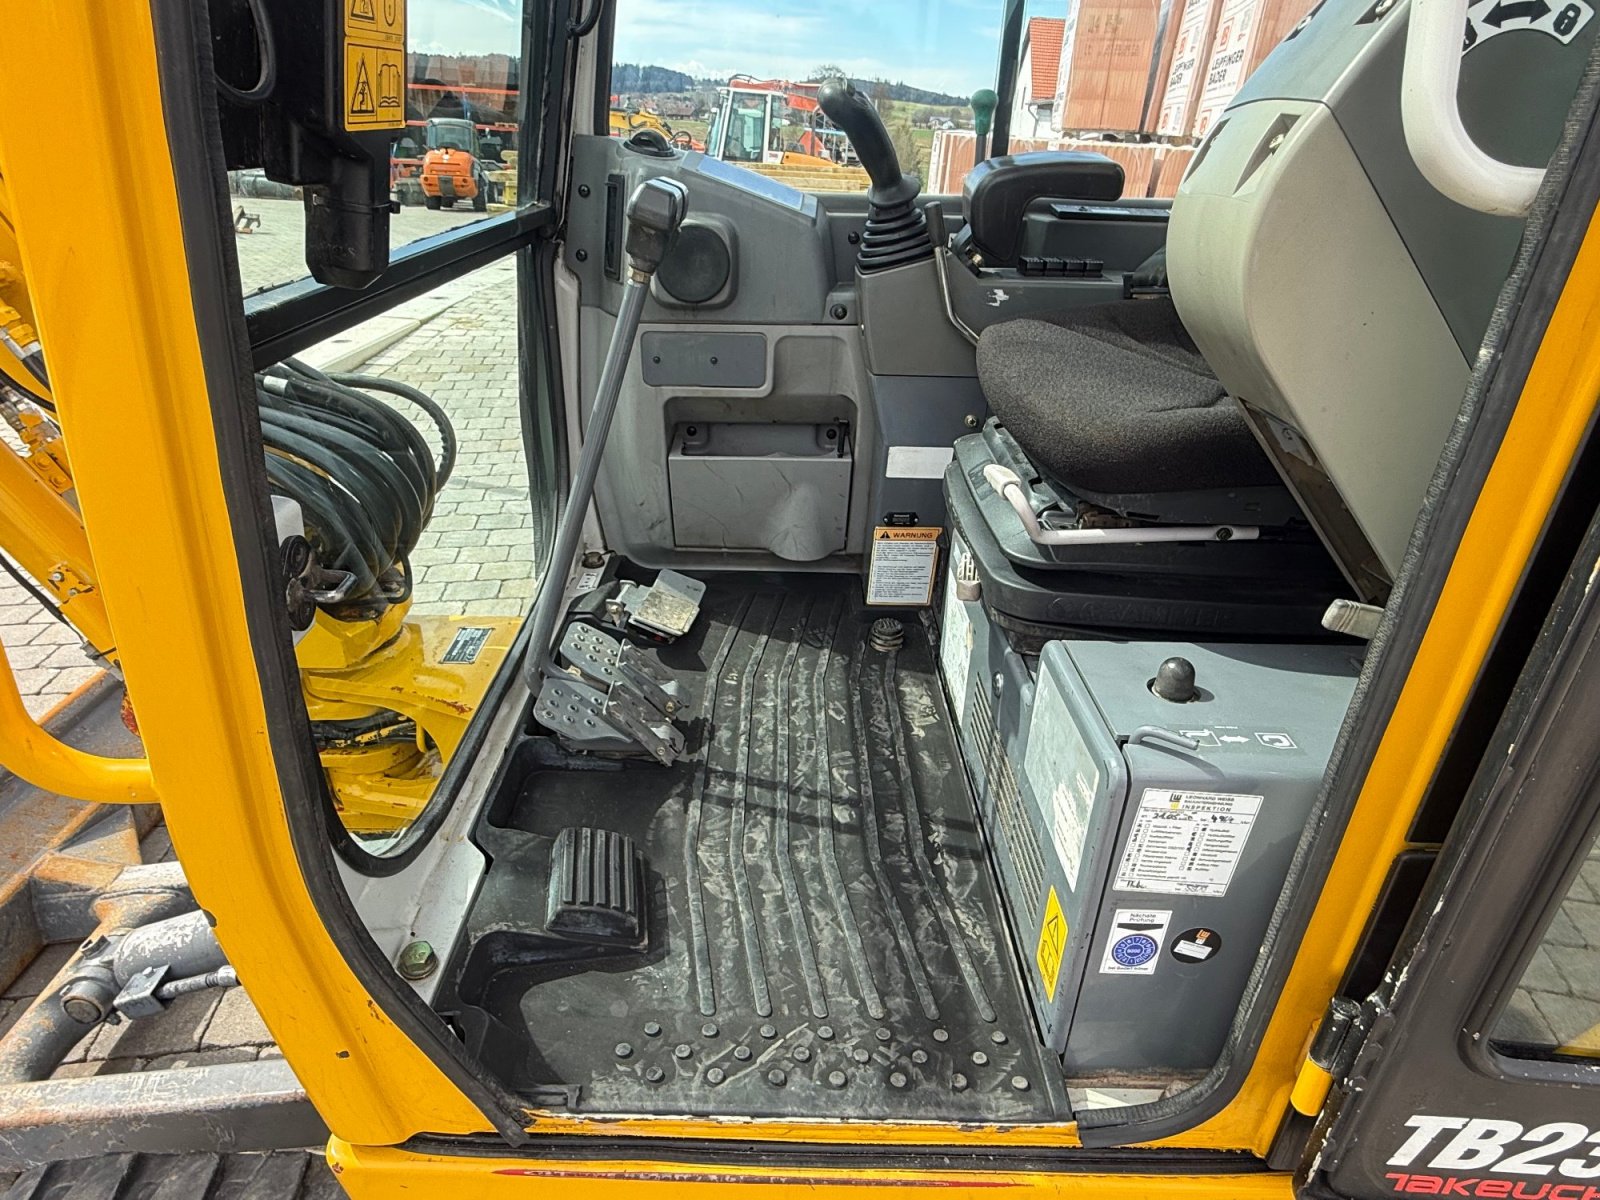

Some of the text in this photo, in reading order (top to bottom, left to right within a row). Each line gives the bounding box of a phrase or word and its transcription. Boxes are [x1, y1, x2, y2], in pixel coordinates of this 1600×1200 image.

[1211, 49, 1245, 71] LEIPFINGER
[1208, 68, 1228, 85] BADER
[1182, 804, 1232, 812] INSPEKTION
